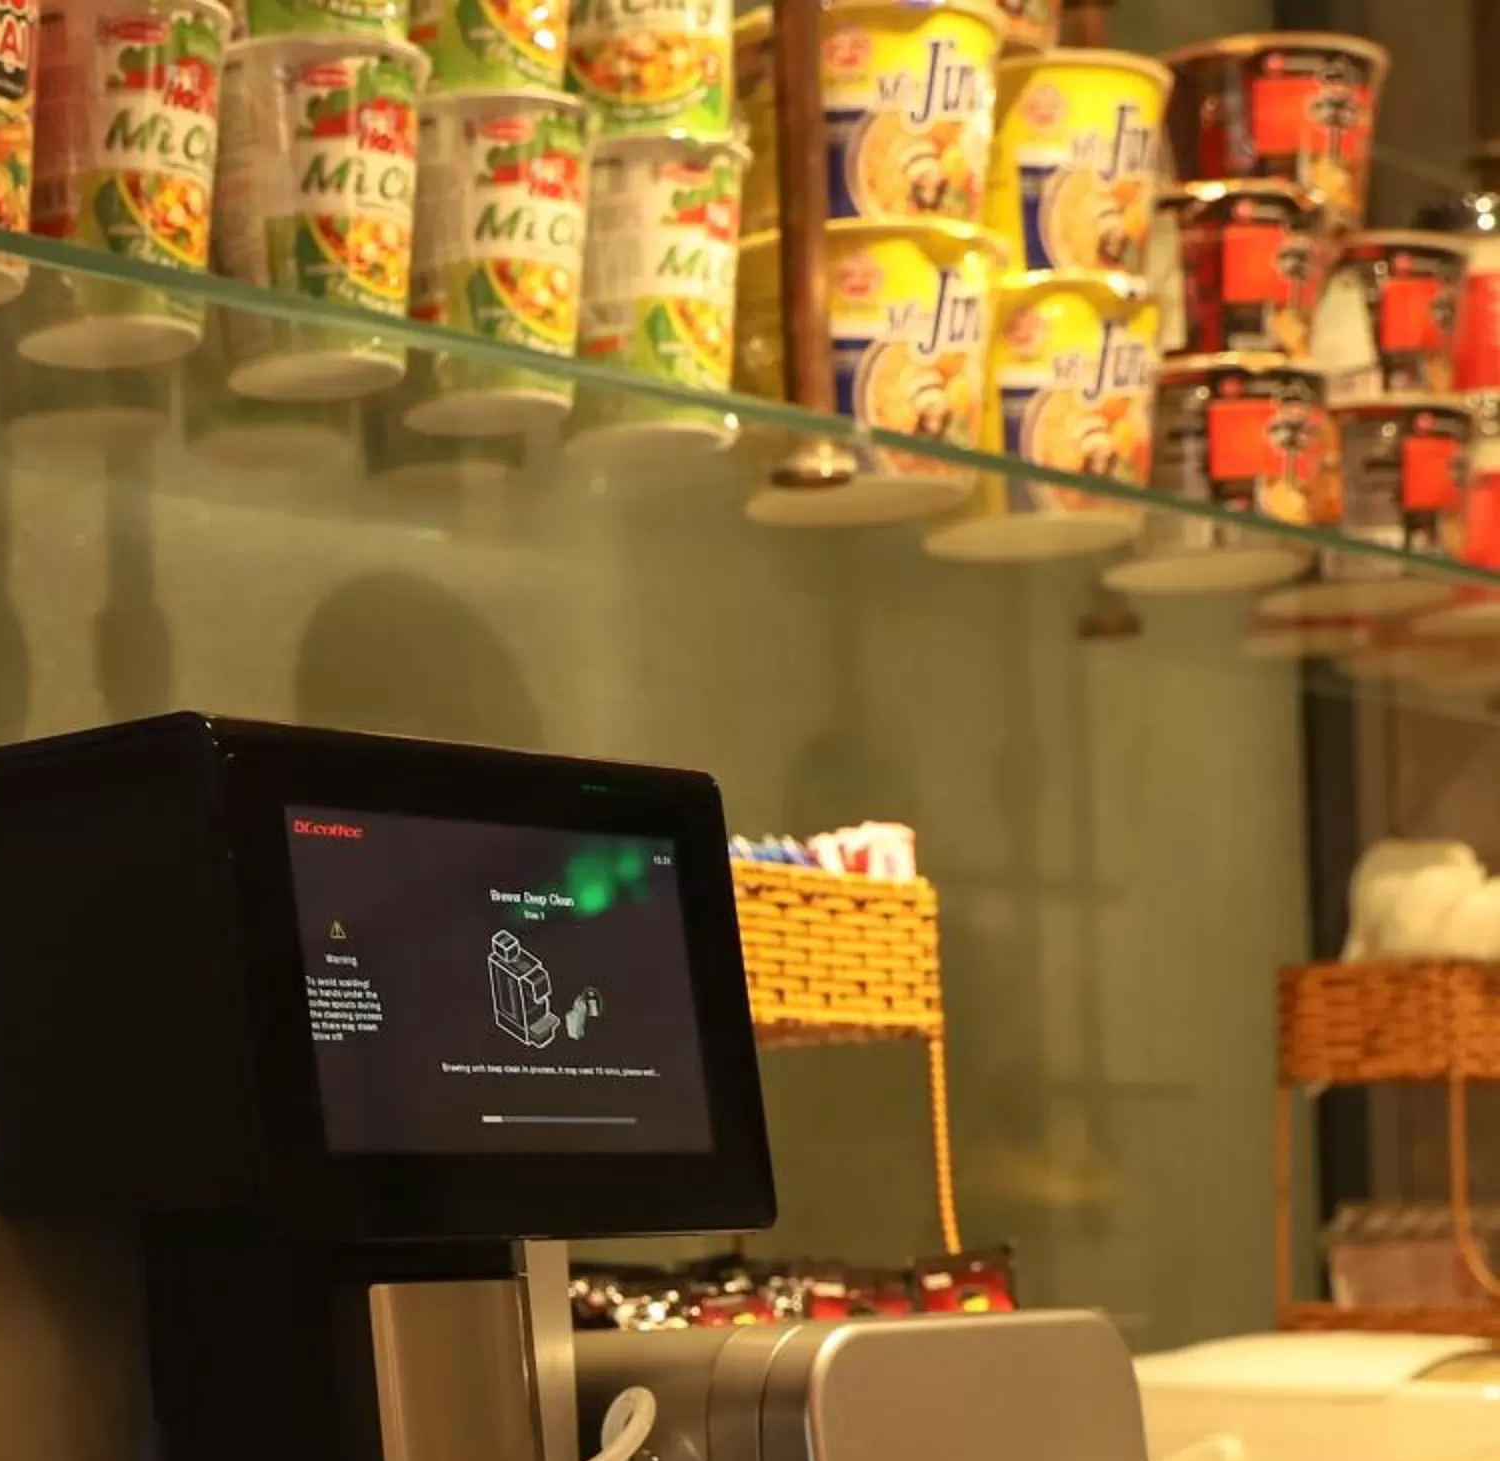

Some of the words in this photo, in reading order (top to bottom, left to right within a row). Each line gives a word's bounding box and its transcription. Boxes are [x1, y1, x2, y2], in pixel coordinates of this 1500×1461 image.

[301, 152, 367, 195] Mì
[475, 202, 535, 242] Mì
[323, 953, 358, 968] Warning
